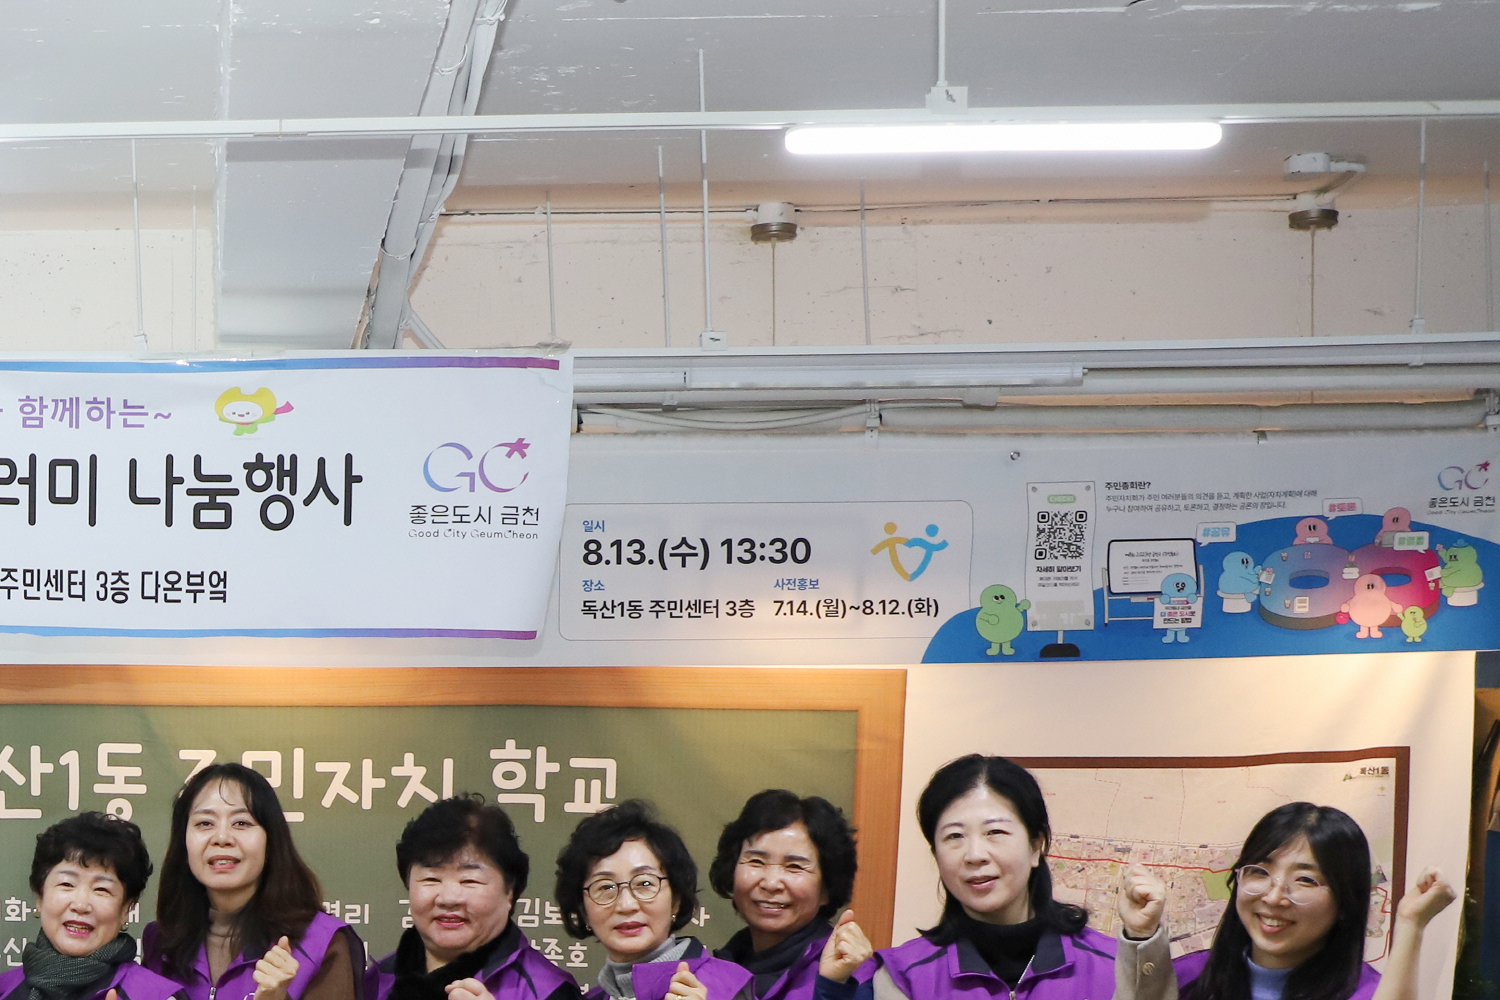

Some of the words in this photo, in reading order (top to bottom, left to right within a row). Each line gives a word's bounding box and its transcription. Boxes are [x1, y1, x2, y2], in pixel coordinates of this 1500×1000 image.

[18, 395, 171, 429] 함께하는~
[129, 453, 363, 531] 나눔행사
[1429, 496, 1469, 508] 좋은도시
[1473, 495, 1496, 507] 금천
[409, 504, 493, 527] 좋은도시
[501, 506, 539, 525] 금천
[583, 520, 604, 532] 일시
[408, 529, 440, 539] Good
[444, 529, 468, 541] City
[470, 529, 539, 541] GeumCheon
[583, 537, 709, 570] 8.13.(수)
[721, 538, 811, 564] 13:30
[0, 568, 85, 601] 주민센터
[97, 571, 129, 604] 3층
[141, 571, 227, 603] 다온부엌
[583, 580, 605, 592] 장소
[774, 578, 819, 590] 사전홍보
[580, 599, 642, 620] 독산1동
[649, 599, 719, 620] 주민센터
[726, 599, 755, 618] 3층
[773, 598, 939, 619] 7.14.(월)~8.12.(화)
[177, 747, 454, 823] 민자치
[488, 738, 618, 824] 학교
